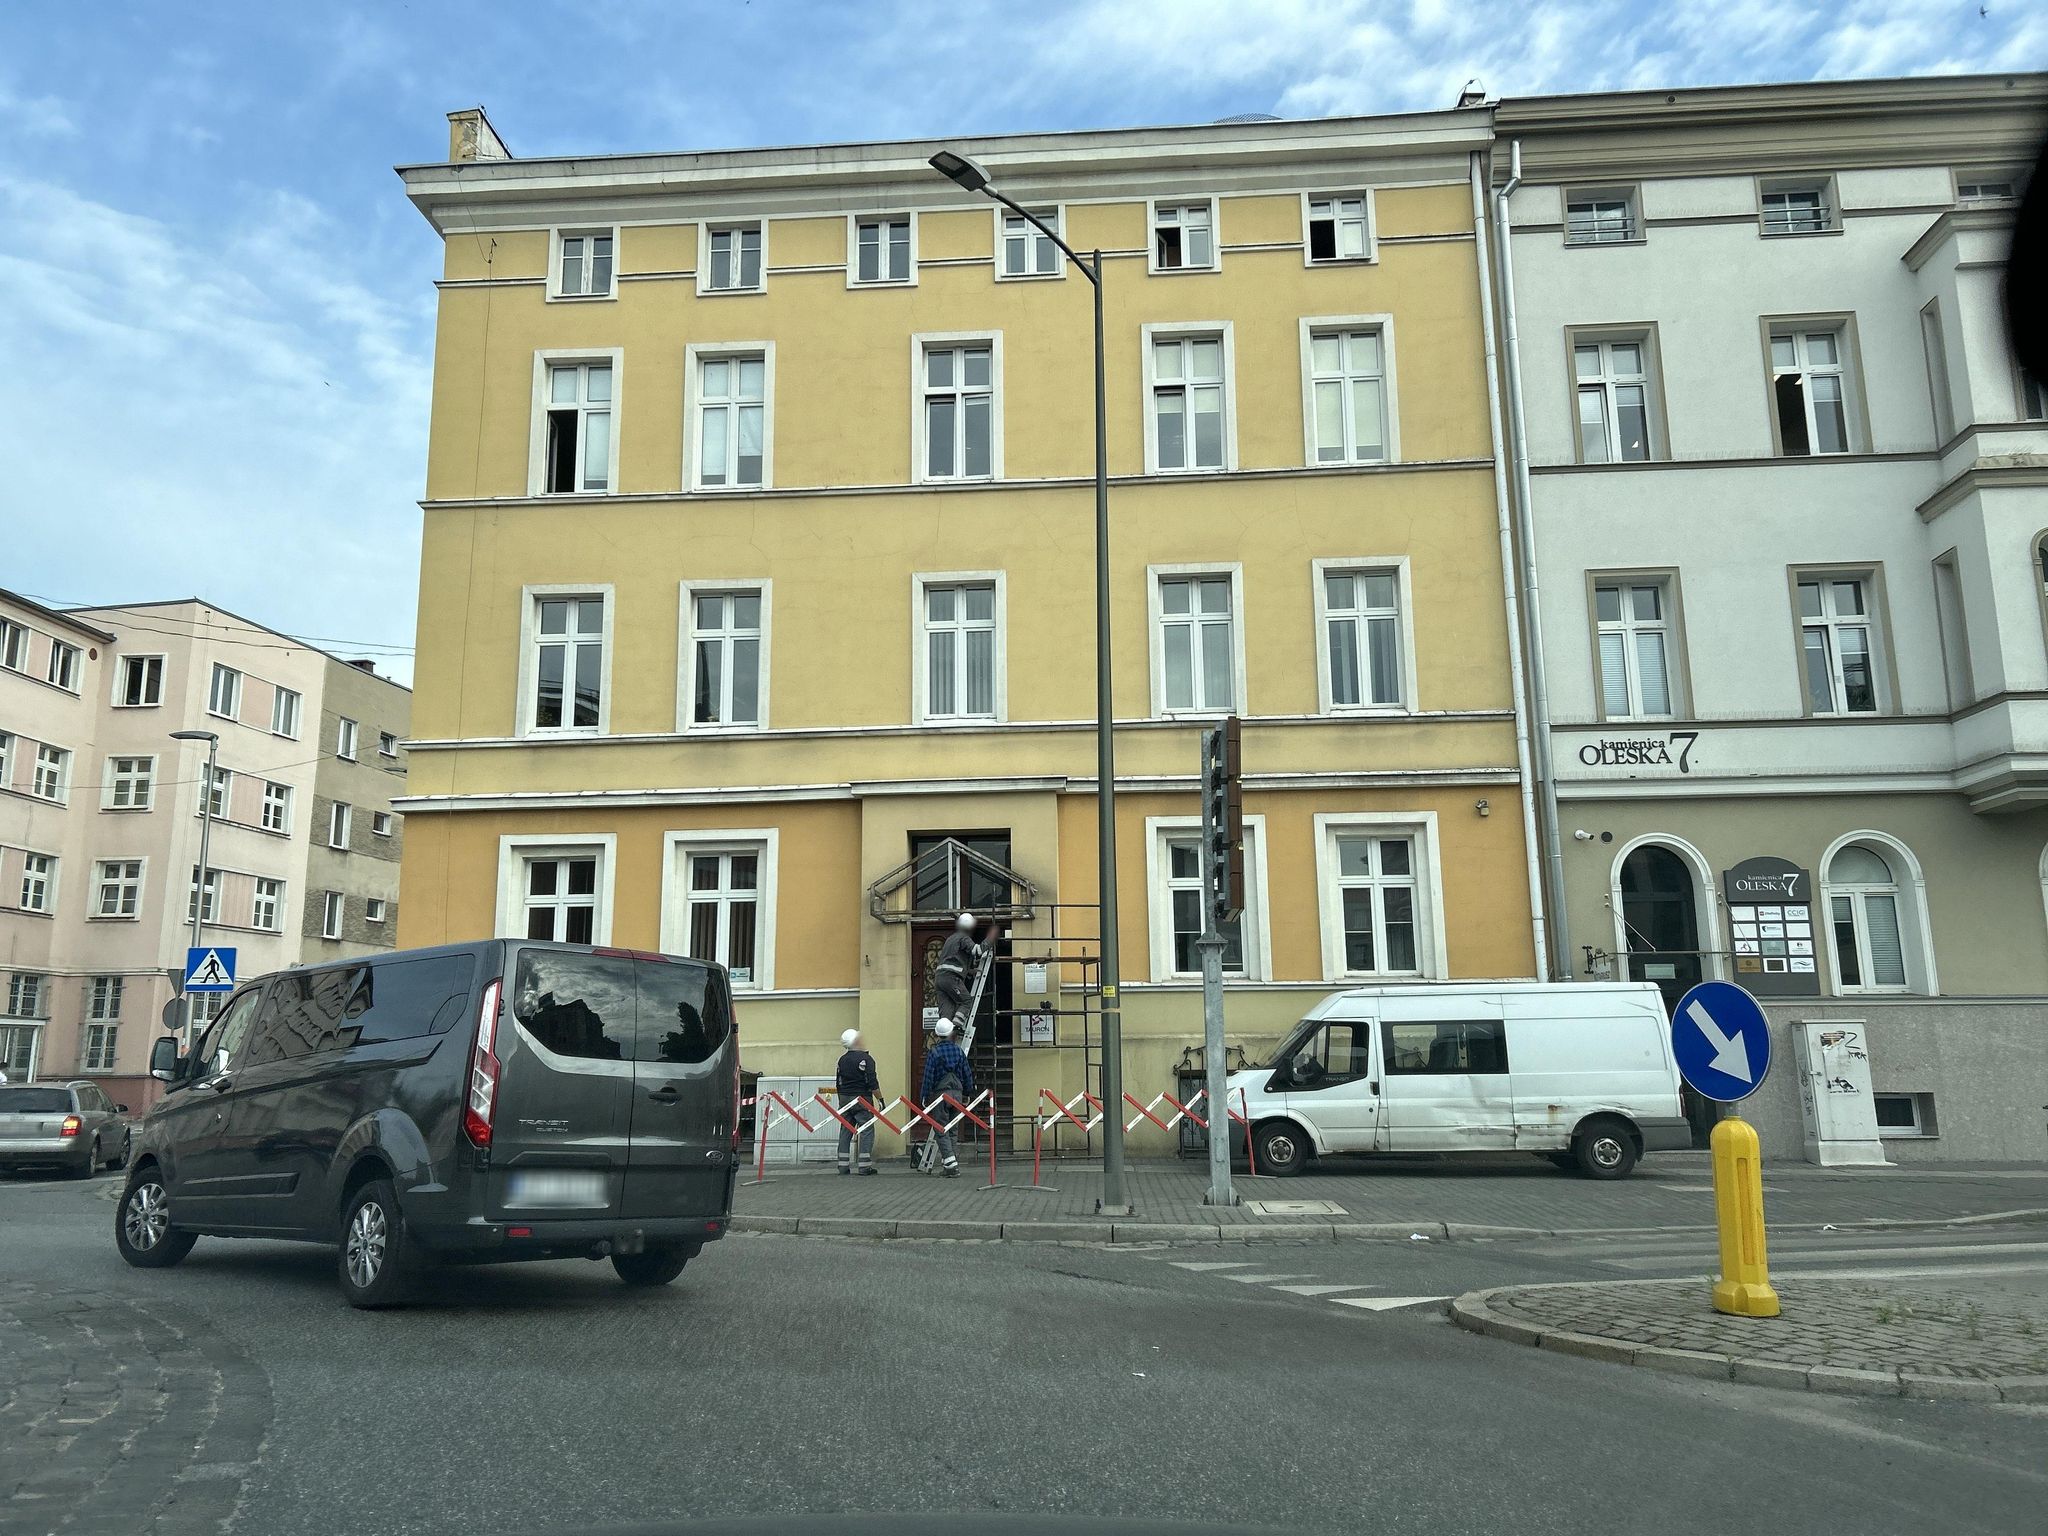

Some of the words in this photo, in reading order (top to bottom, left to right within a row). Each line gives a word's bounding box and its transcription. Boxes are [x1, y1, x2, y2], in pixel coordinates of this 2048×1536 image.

[1600, 738, 1665, 750] kamienica
[1579, 745, 1673, 765] OLESKA
[1736, 879, 1788, 891] OLESKA
